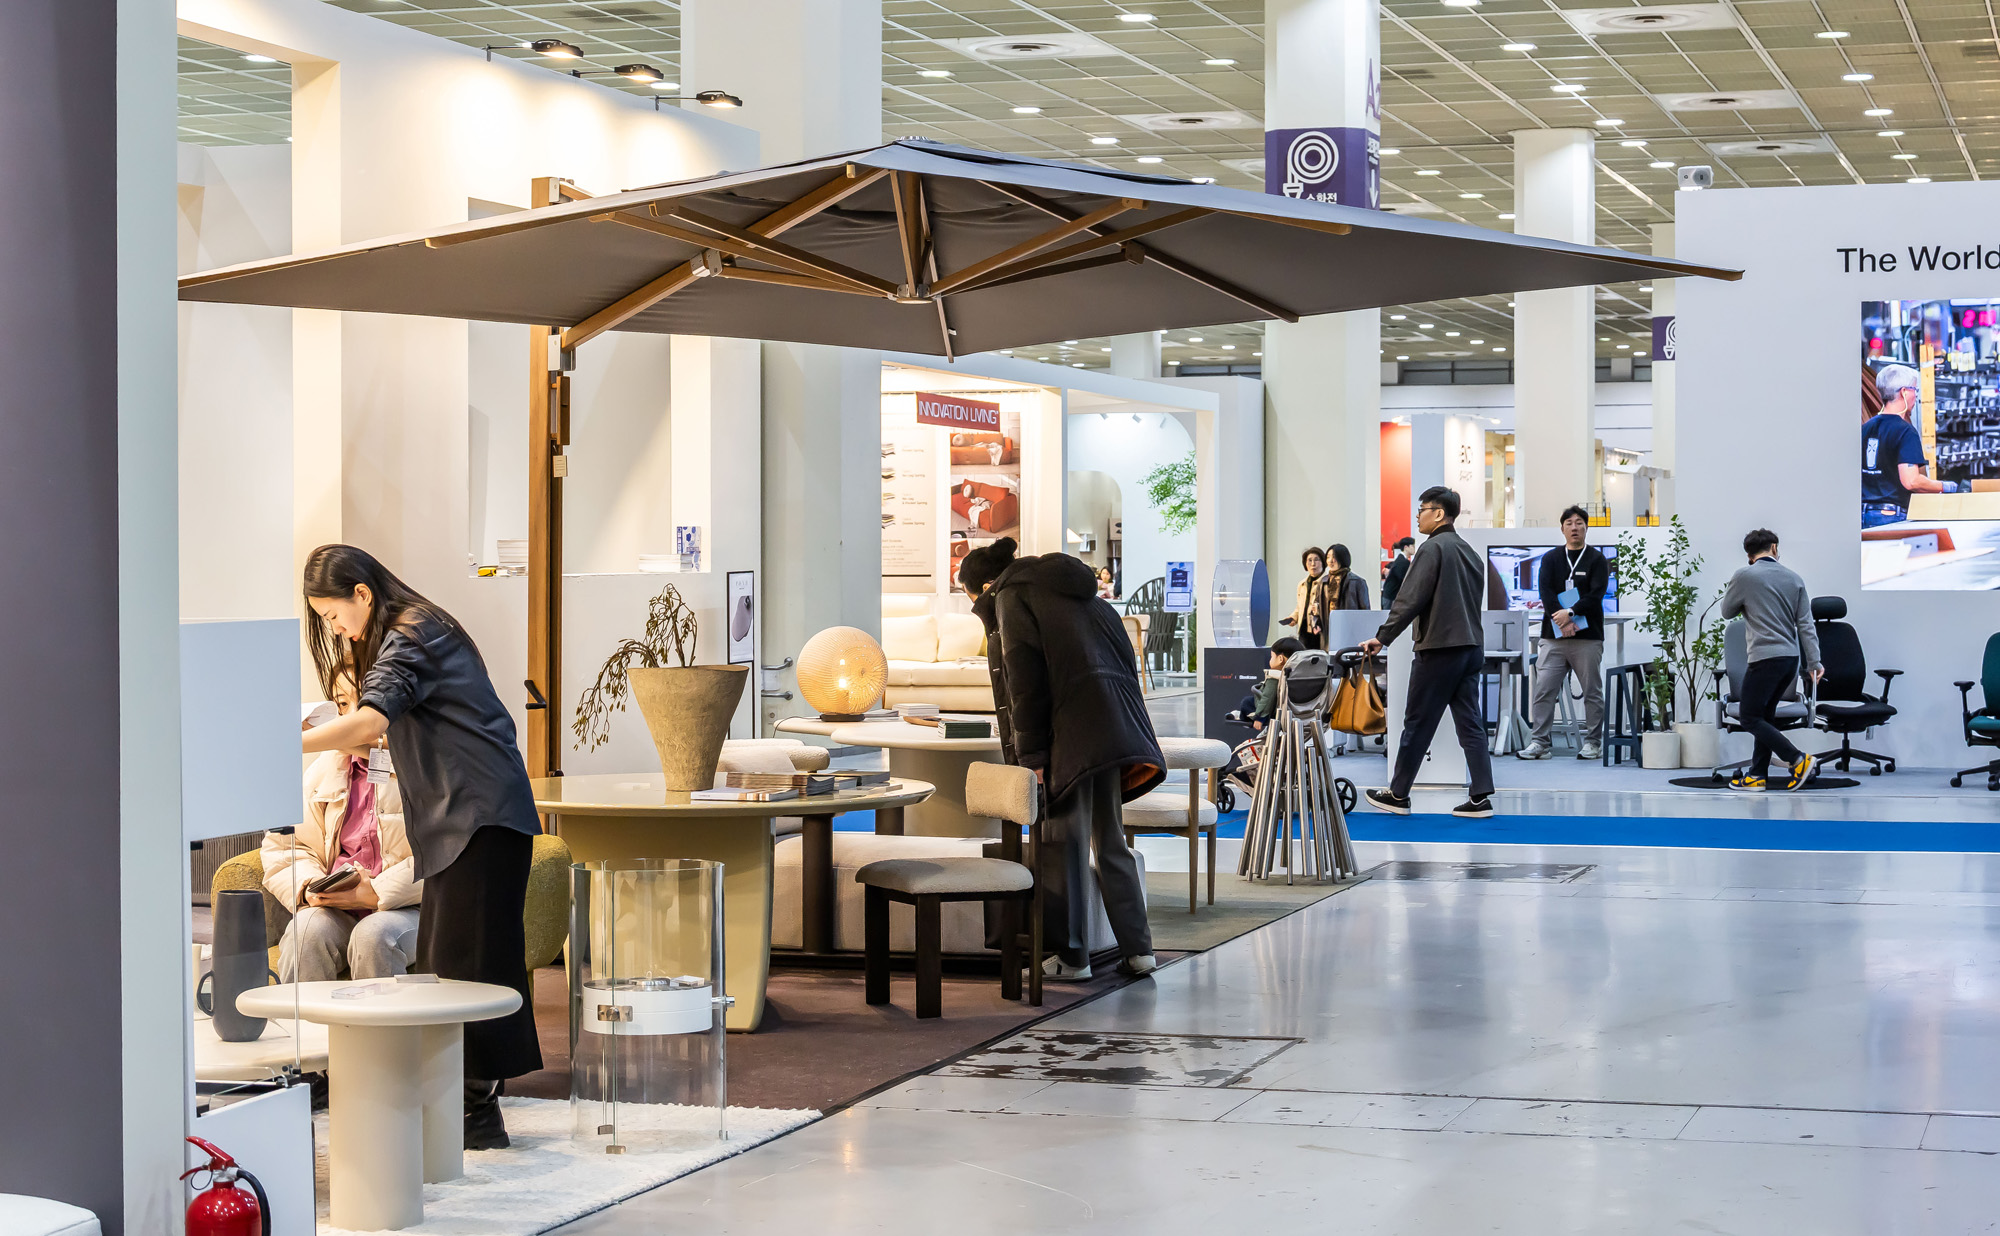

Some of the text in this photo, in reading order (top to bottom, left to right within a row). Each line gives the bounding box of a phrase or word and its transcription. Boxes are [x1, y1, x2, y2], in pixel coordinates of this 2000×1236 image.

[1837, 244, 2000, 273] The World
[918, 400, 968, 421] INNOVATION
